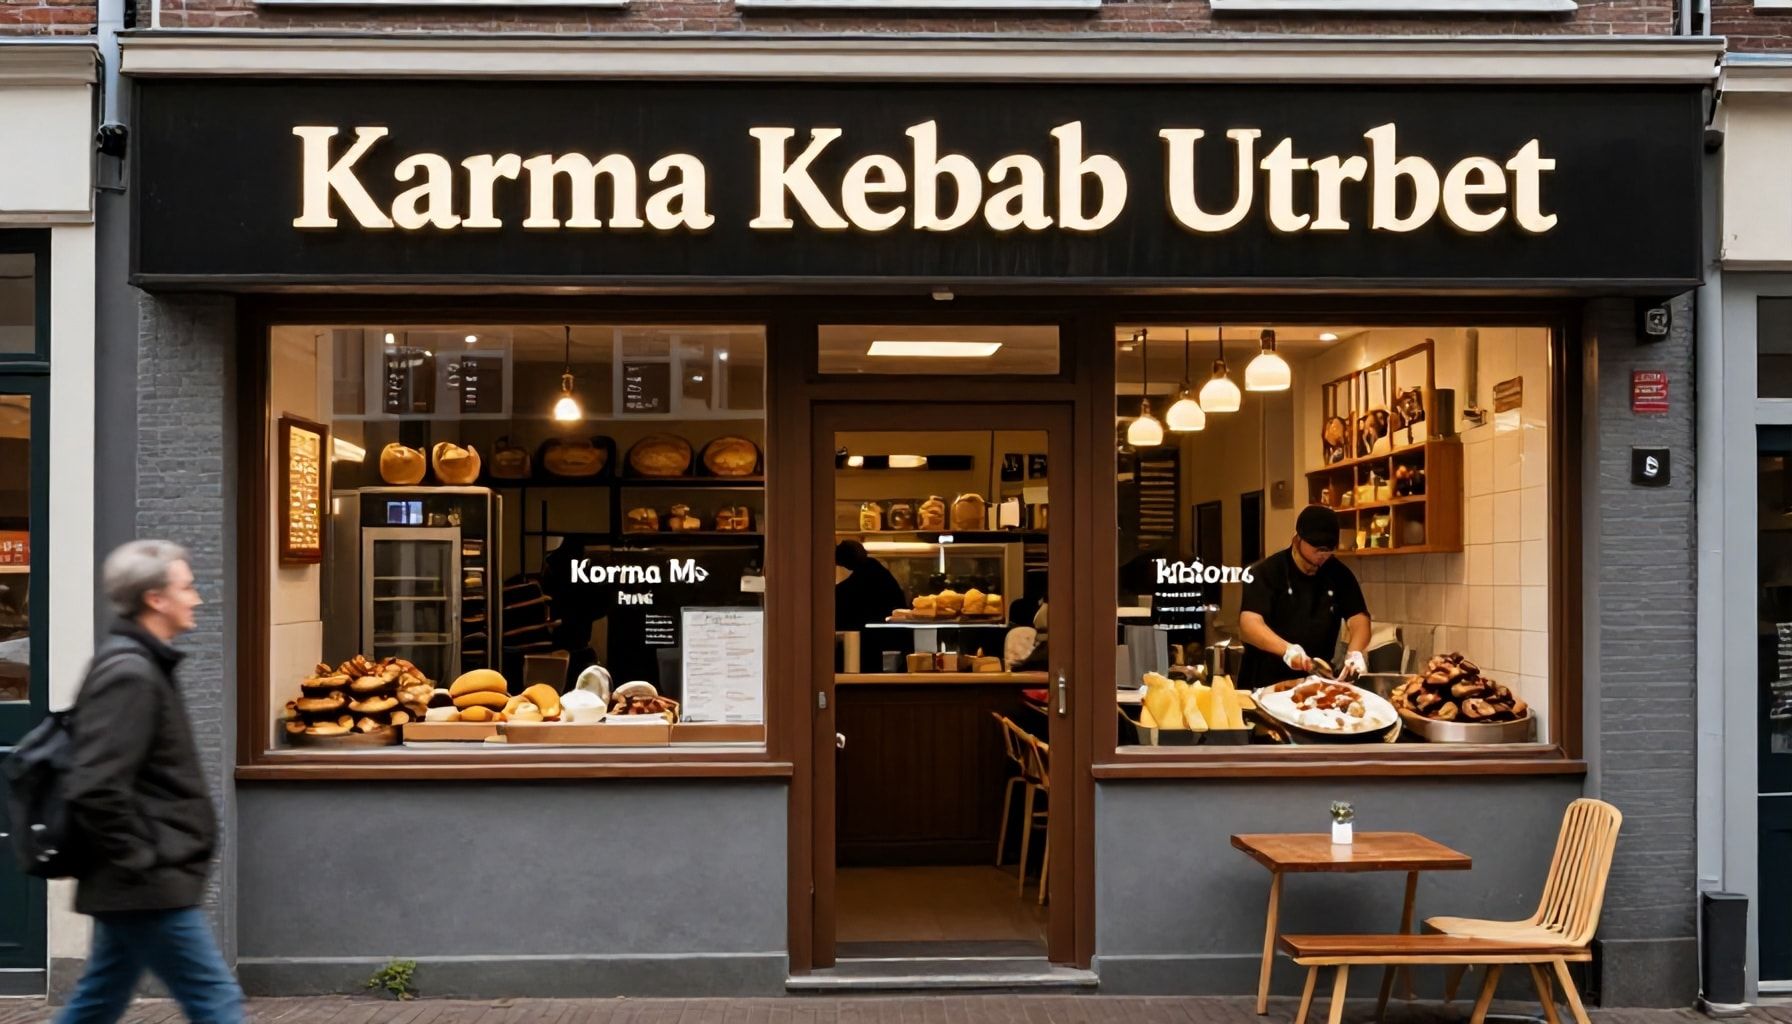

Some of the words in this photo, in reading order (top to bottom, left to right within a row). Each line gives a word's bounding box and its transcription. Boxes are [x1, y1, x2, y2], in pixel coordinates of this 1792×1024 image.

[293, 125, 716, 231] Karma
[748, 120, 1128, 233] Kebab
[1159, 122, 1558, 234] Utrbet
[570, 558, 662, 584] Korma
